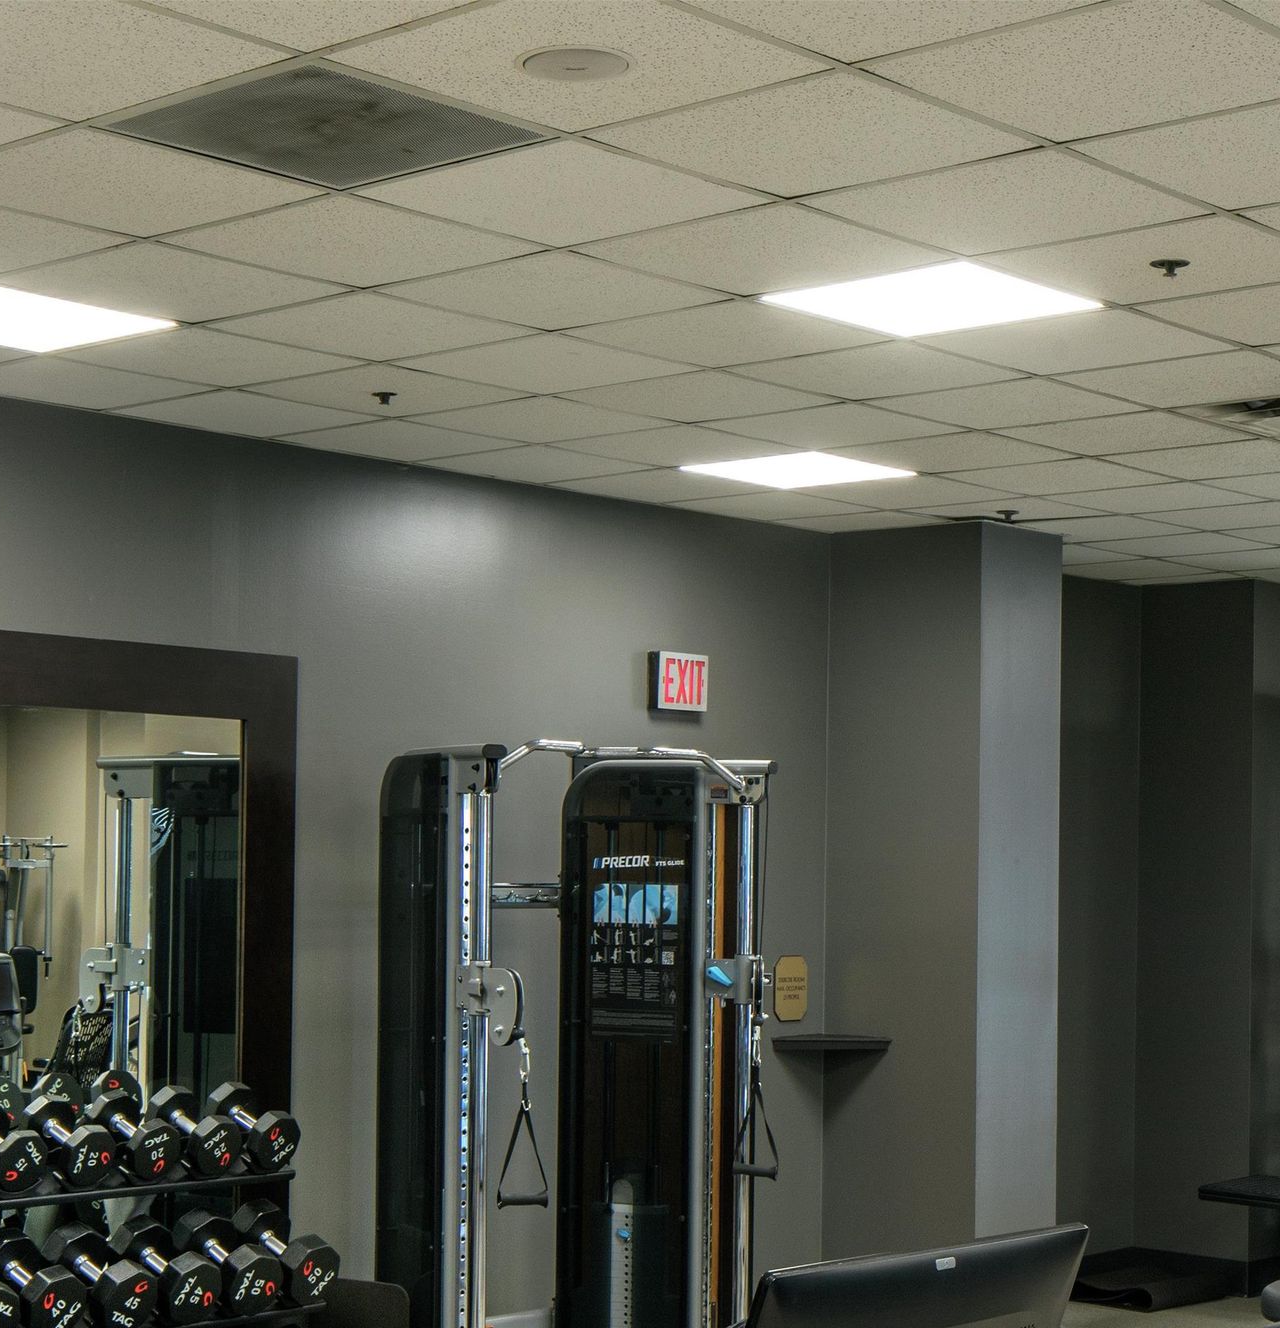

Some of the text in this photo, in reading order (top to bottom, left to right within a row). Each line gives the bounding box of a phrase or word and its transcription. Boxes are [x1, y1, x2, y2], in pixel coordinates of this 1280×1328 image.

[664, 658, 705, 705] EXIT
[601, 855, 650, 869] PRECOR
[145, 1133, 169, 1147] TAG
[204, 1130, 228, 1149] TAG
[273, 1136, 285, 1149] 25
[26, 1141, 42, 1165] TAG
[151, 1148, 164, 1160] 20
[214, 1143, 227, 1157] 25
[272, 1143, 295, 1163] TAG
[16, 1159, 28, 1172] 15
[73, 1145, 88, 1174] TAG
[87, 1152, 99, 1166] 20
[308, 1268, 322, 1284] 50
[310, 1271, 334, 1296] TAG
[174, 1275, 197, 1306] TAG
[235, 1269, 255, 1301] TAG
[251, 1279, 265, 1295] 50
[124, 1297, 141, 1309] 45
[190, 1286, 203, 1304] 45
[51, 1300, 66, 1317] 40
[112, 1311, 134, 1328] TAG
